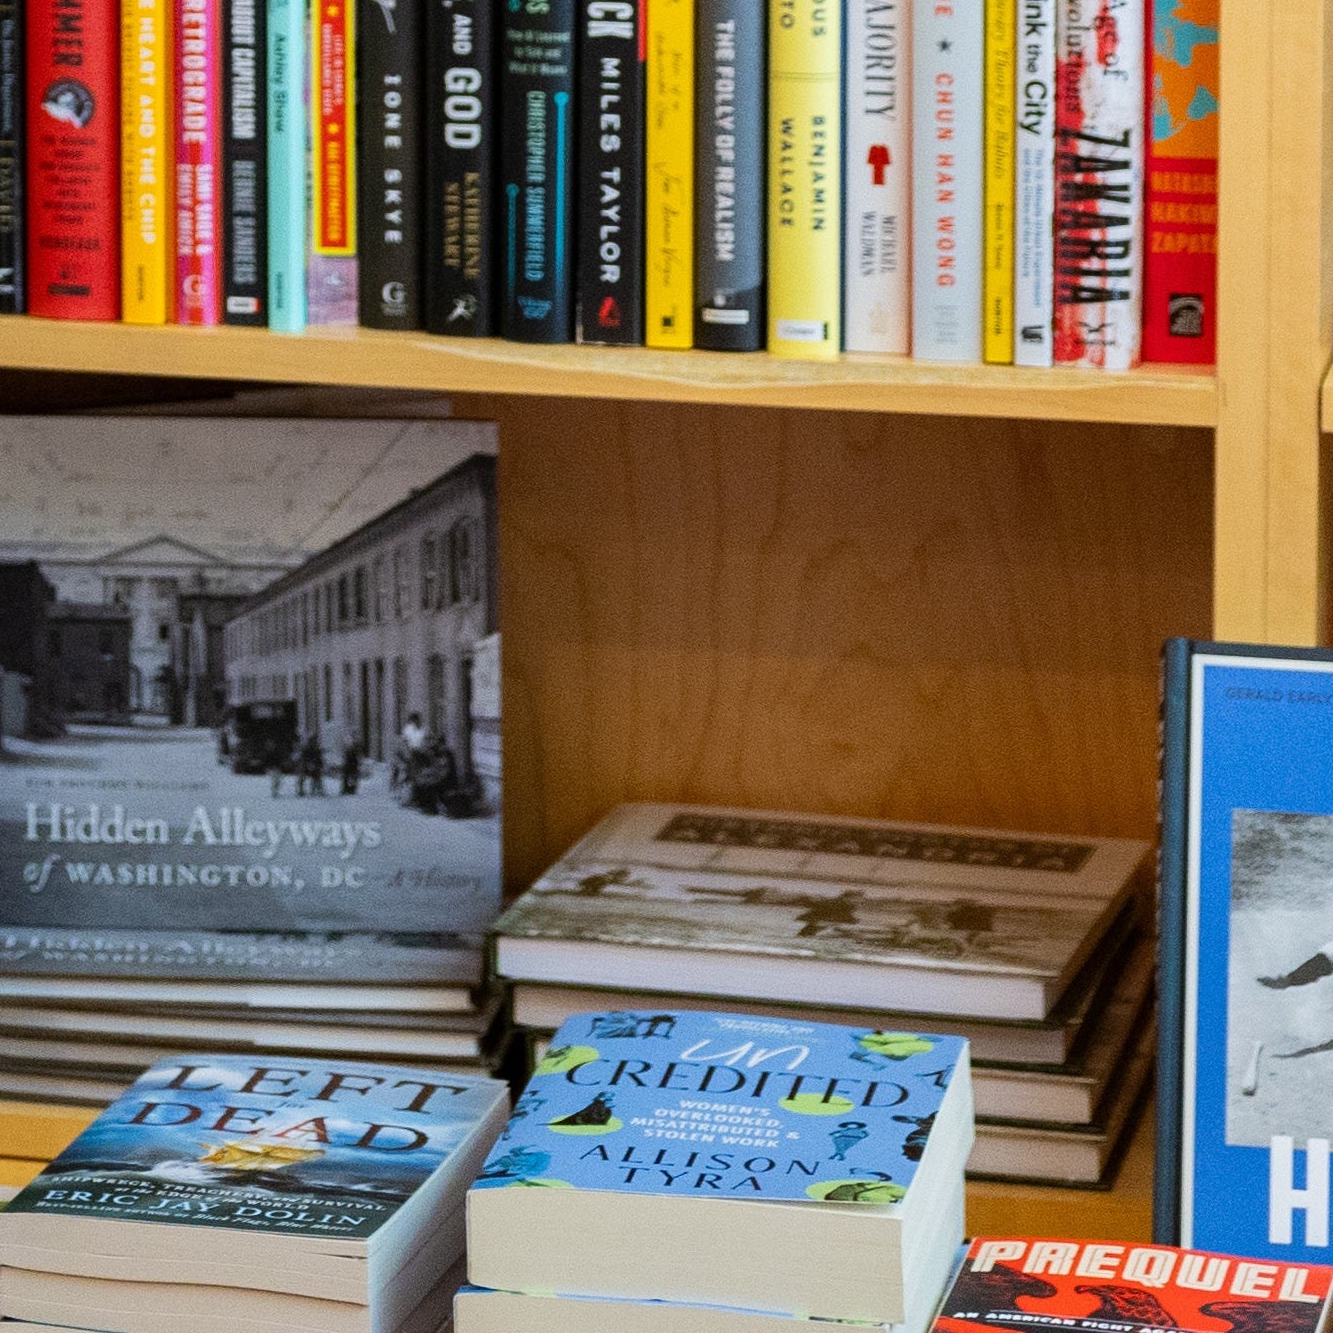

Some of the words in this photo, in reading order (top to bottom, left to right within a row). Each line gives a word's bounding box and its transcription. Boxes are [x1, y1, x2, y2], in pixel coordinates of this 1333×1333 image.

[453, 14, 472, 55] AND
[1027, 44, 1045, 74] the
[444, 67, 482, 151] GOD
[1021, 83, 1047, 136] City
[1058, 128, 1131, 305] ZAKARIA
[26, 803, 169, 845] Hidden
[184, 805, 381, 861] Alleyways
[23, 853, 60, 892] of
[66, 863, 306, 889] WASHINGTON,
[320, 867, 365, 888] DC
[162, 1065, 467, 1115] LEFT
[566, 1059, 909, 1107] CREDITED
[126, 1101, 429, 1152] DEAD
[630, 1117, 782, 1139] MISATTRIBUTED
[655, 1109, 783, 1128] OVERLOOKED,
[679, 1100, 771, 1117] WOMEN'S
[644, 1129, 716, 1144] STOLEN
[721, 1135, 780, 1148] WORK
[581, 1144, 820, 1176] ALLISON
[619, 1166, 762, 1191] TYRA
[43, 1188, 135, 1207] ERIC
[147, 1198, 220, 1213] JAY
[234, 1205, 368, 1228] DOLIN
[970, 1240, 1322, 1303] PREQUEL
